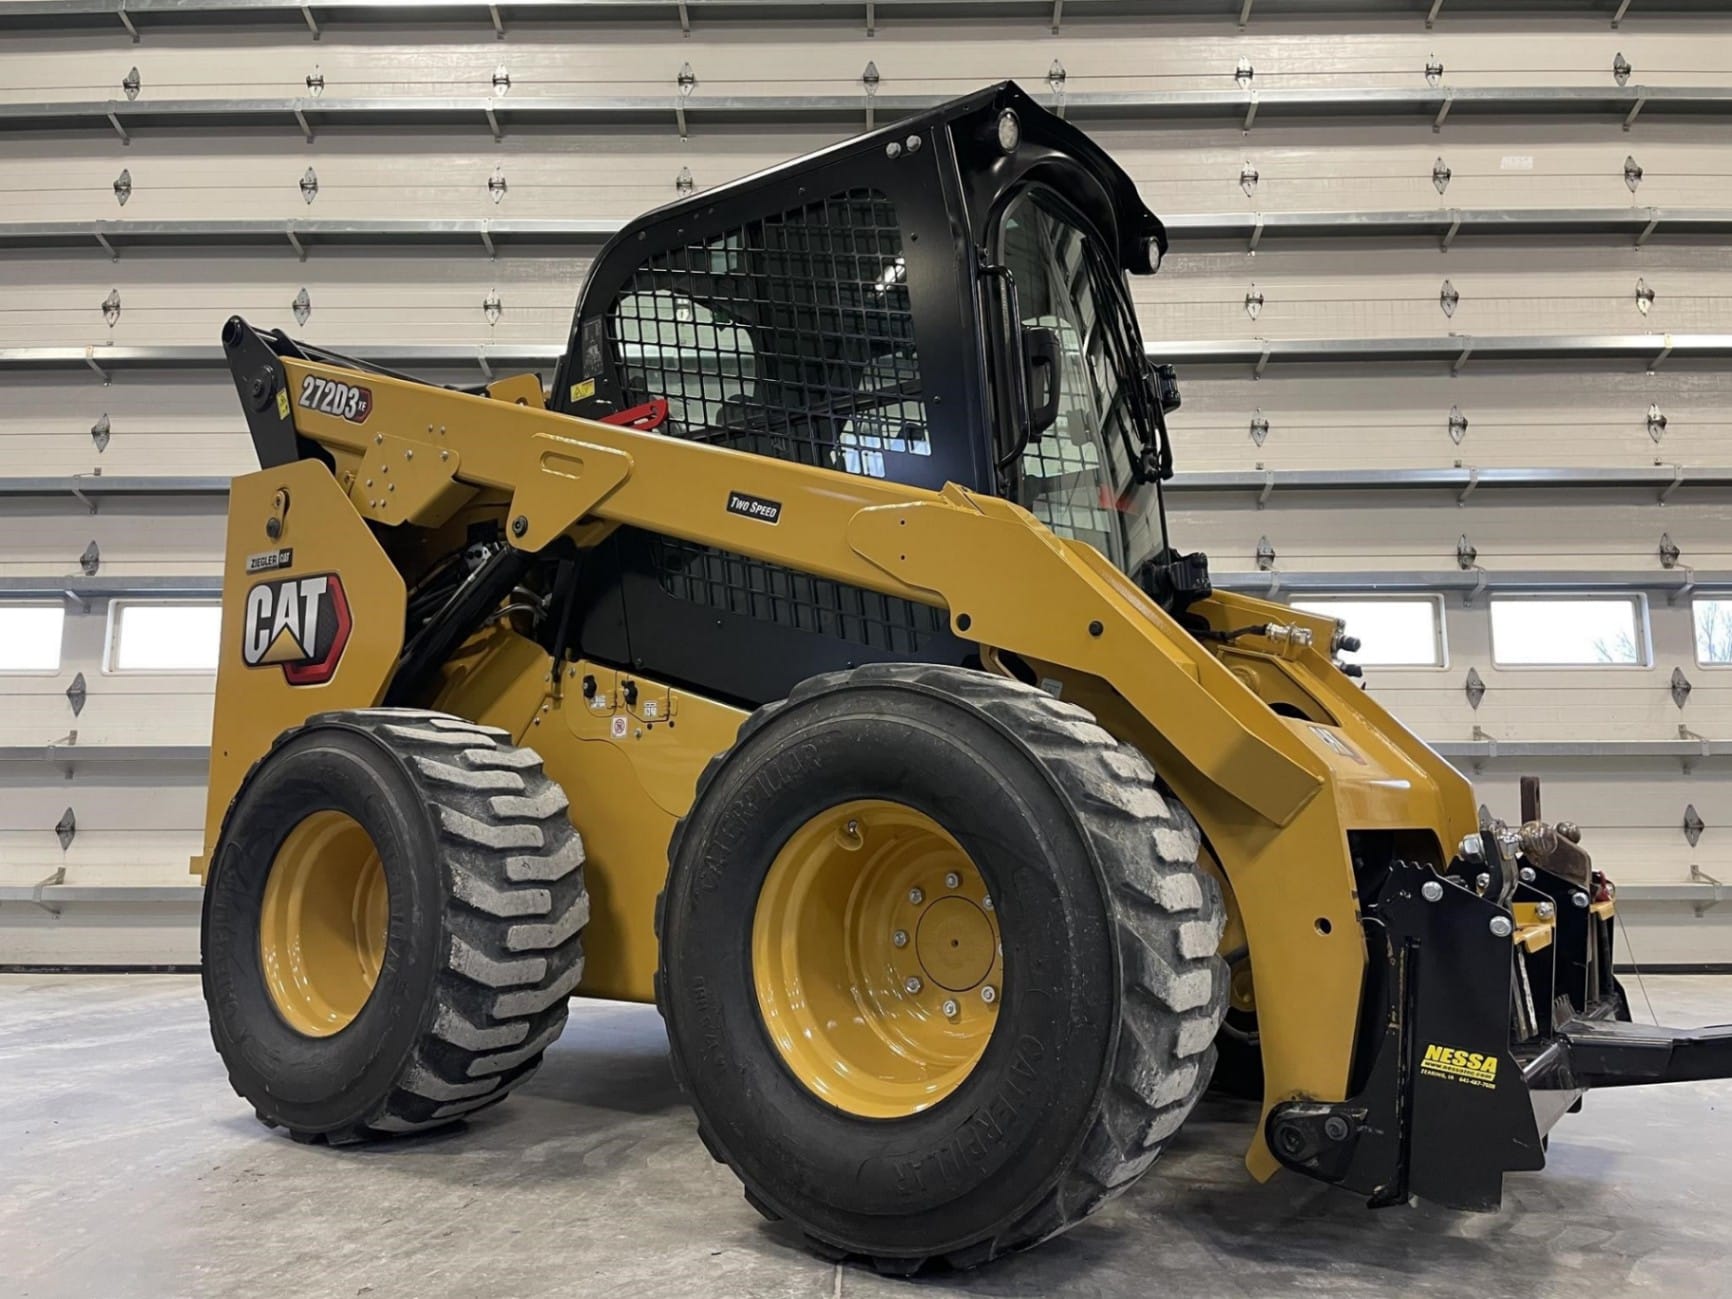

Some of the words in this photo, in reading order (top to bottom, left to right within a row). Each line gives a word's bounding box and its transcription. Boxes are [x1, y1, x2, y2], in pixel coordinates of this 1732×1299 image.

[299, 376, 360, 419] 272D3
[250, 554, 278, 569] ZIEGLER
[244, 575, 329, 664] CAT
[1424, 1043, 1498, 1074] NESSA
